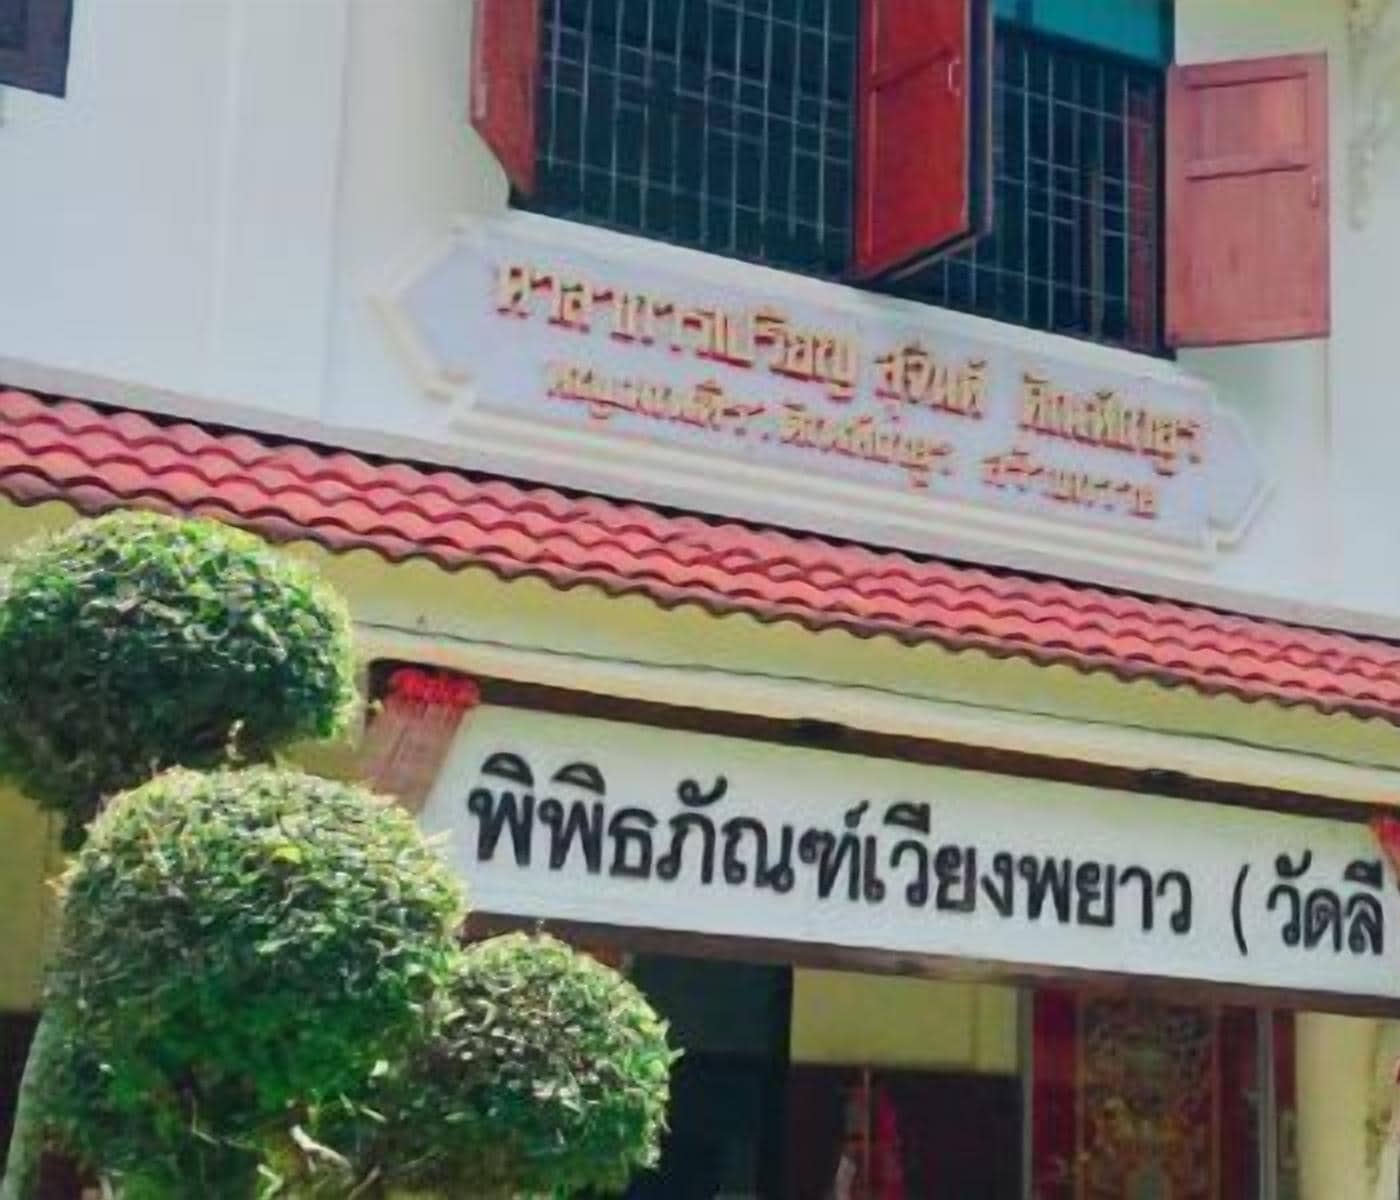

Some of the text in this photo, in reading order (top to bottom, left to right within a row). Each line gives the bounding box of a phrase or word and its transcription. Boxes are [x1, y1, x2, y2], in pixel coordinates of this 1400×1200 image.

[468, 751, 1192, 937] พิพิธภัณฑ์เวียงพยาว
